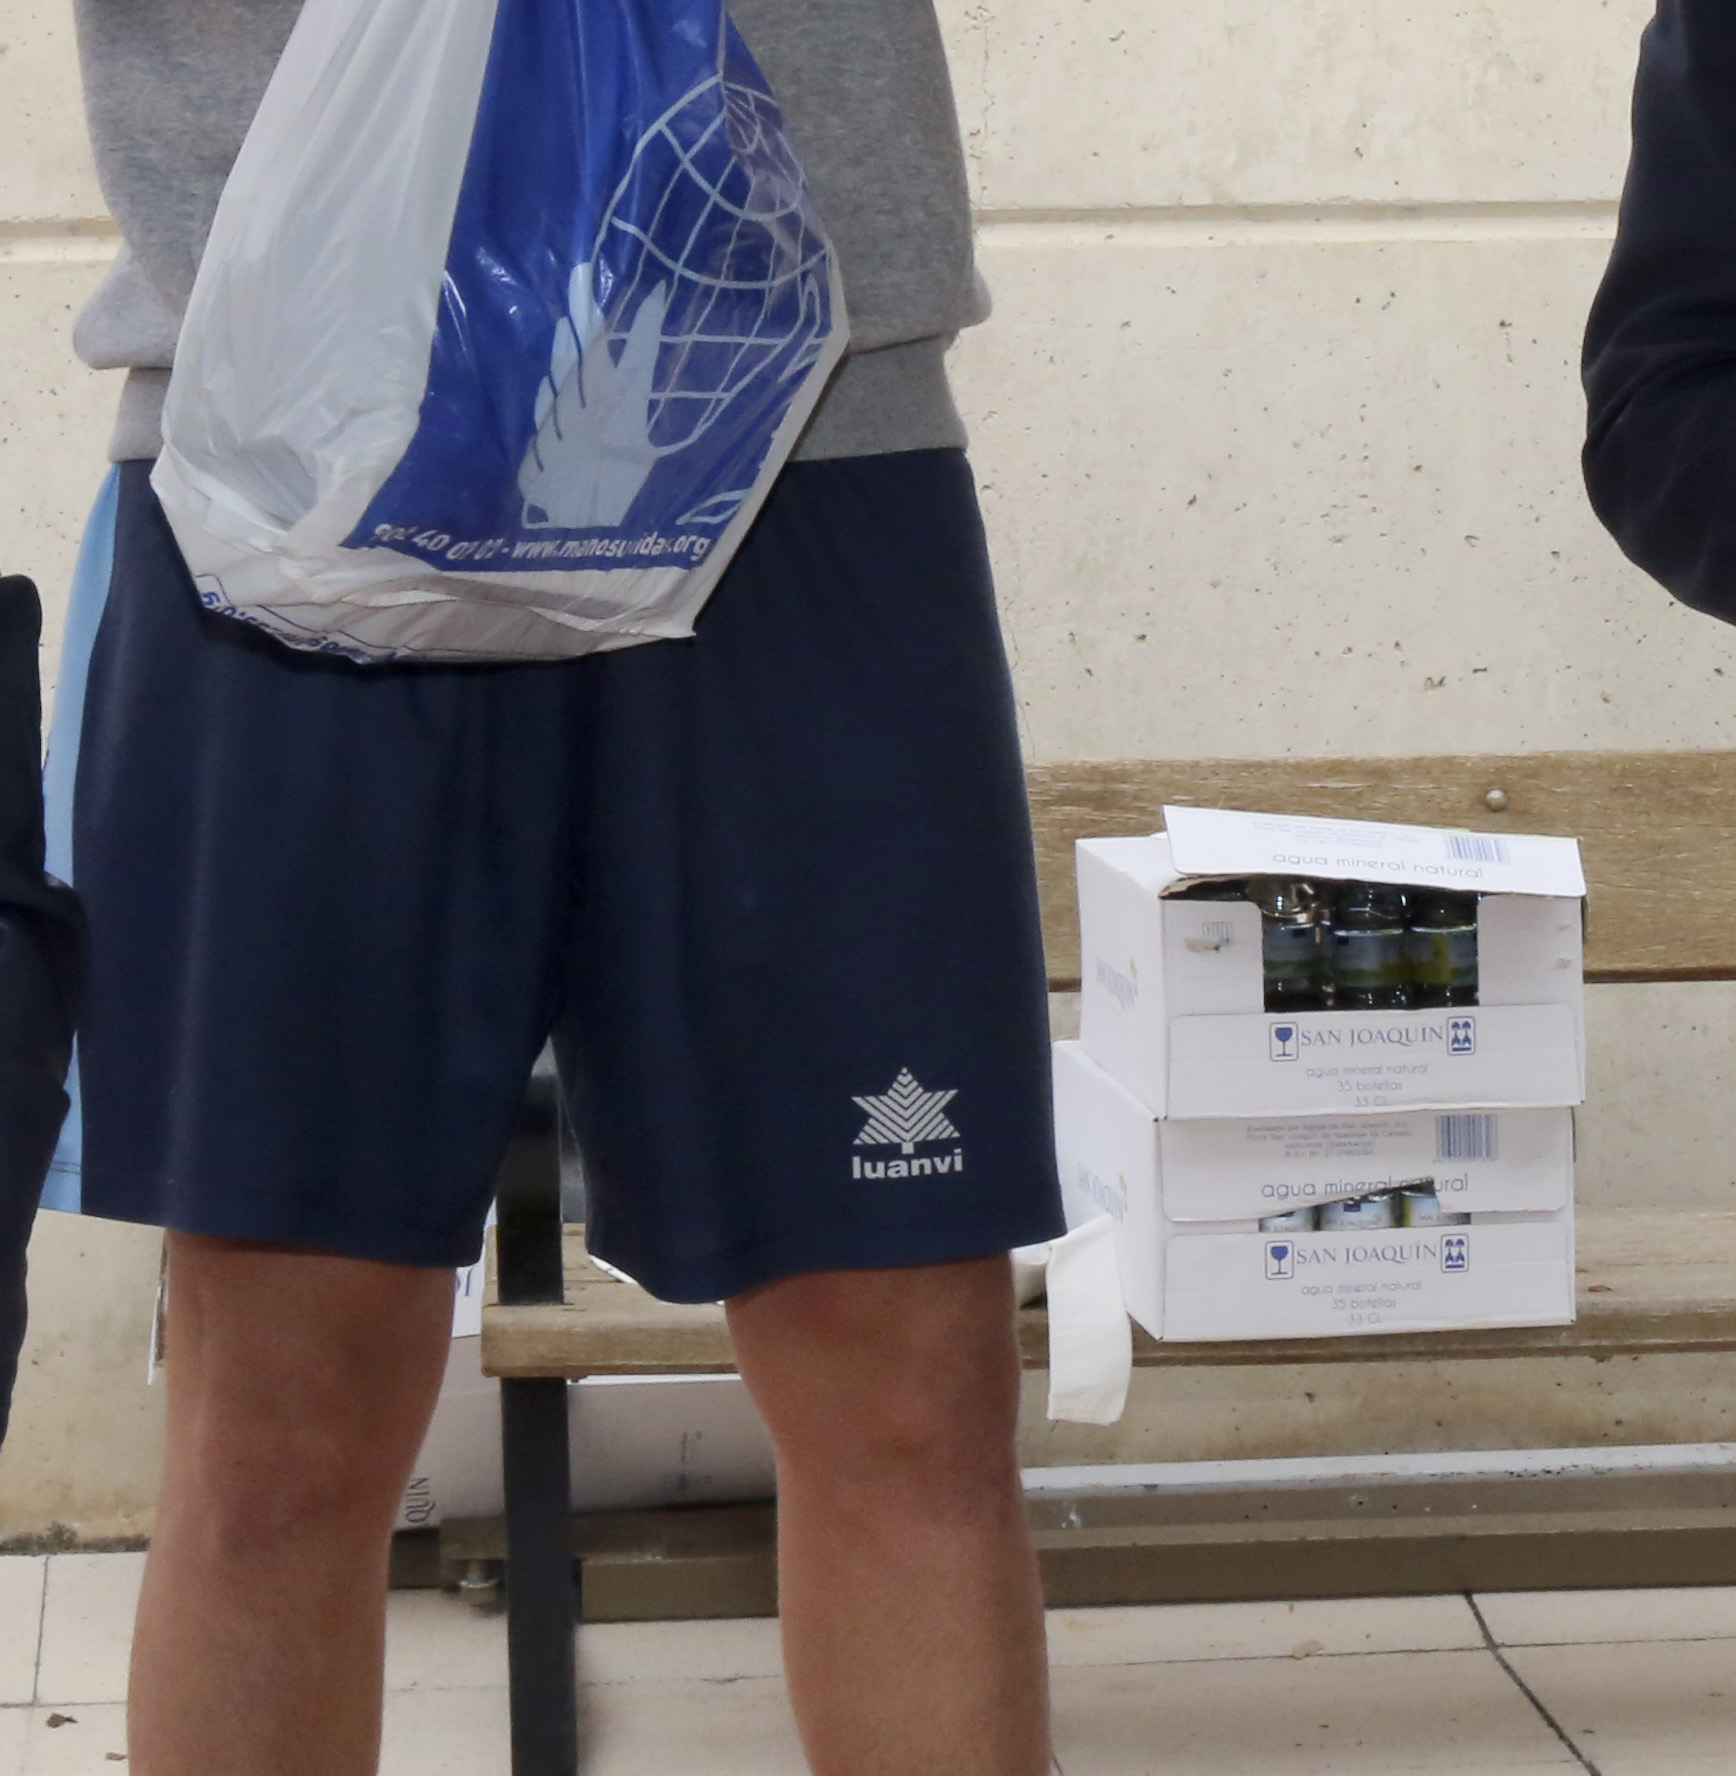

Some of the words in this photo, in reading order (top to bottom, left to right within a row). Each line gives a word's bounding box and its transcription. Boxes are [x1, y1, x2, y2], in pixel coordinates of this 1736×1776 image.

[1272, 852, 1329, 866] agua
[1336, 856, 1406, 871] mineral
[1413, 863, 1484, 879] natural
[1301, 1029, 1342, 1046] SAN
[1307, 1066, 1339, 1078] agua
[1387, 1062, 1428, 1074] natural
[1337, 1080, 1352, 1091] 35
[1356, 1079, 1403, 1091] botellas
[852, 1148, 963, 1180] luanvi
[1261, 1183, 1316, 1200] agua
[1324, 1175, 1392, 1195] mineral
[1296, 1247, 1337, 1265] SAN
[1301, 1285, 1333, 1296] agua
[1381, 1280, 1422, 1291] natural
[1332, 1298, 1346, 1310] 35
[1351, 1297, 1396, 1309] botellas
[405, 1476, 436, 1523] QUIN
